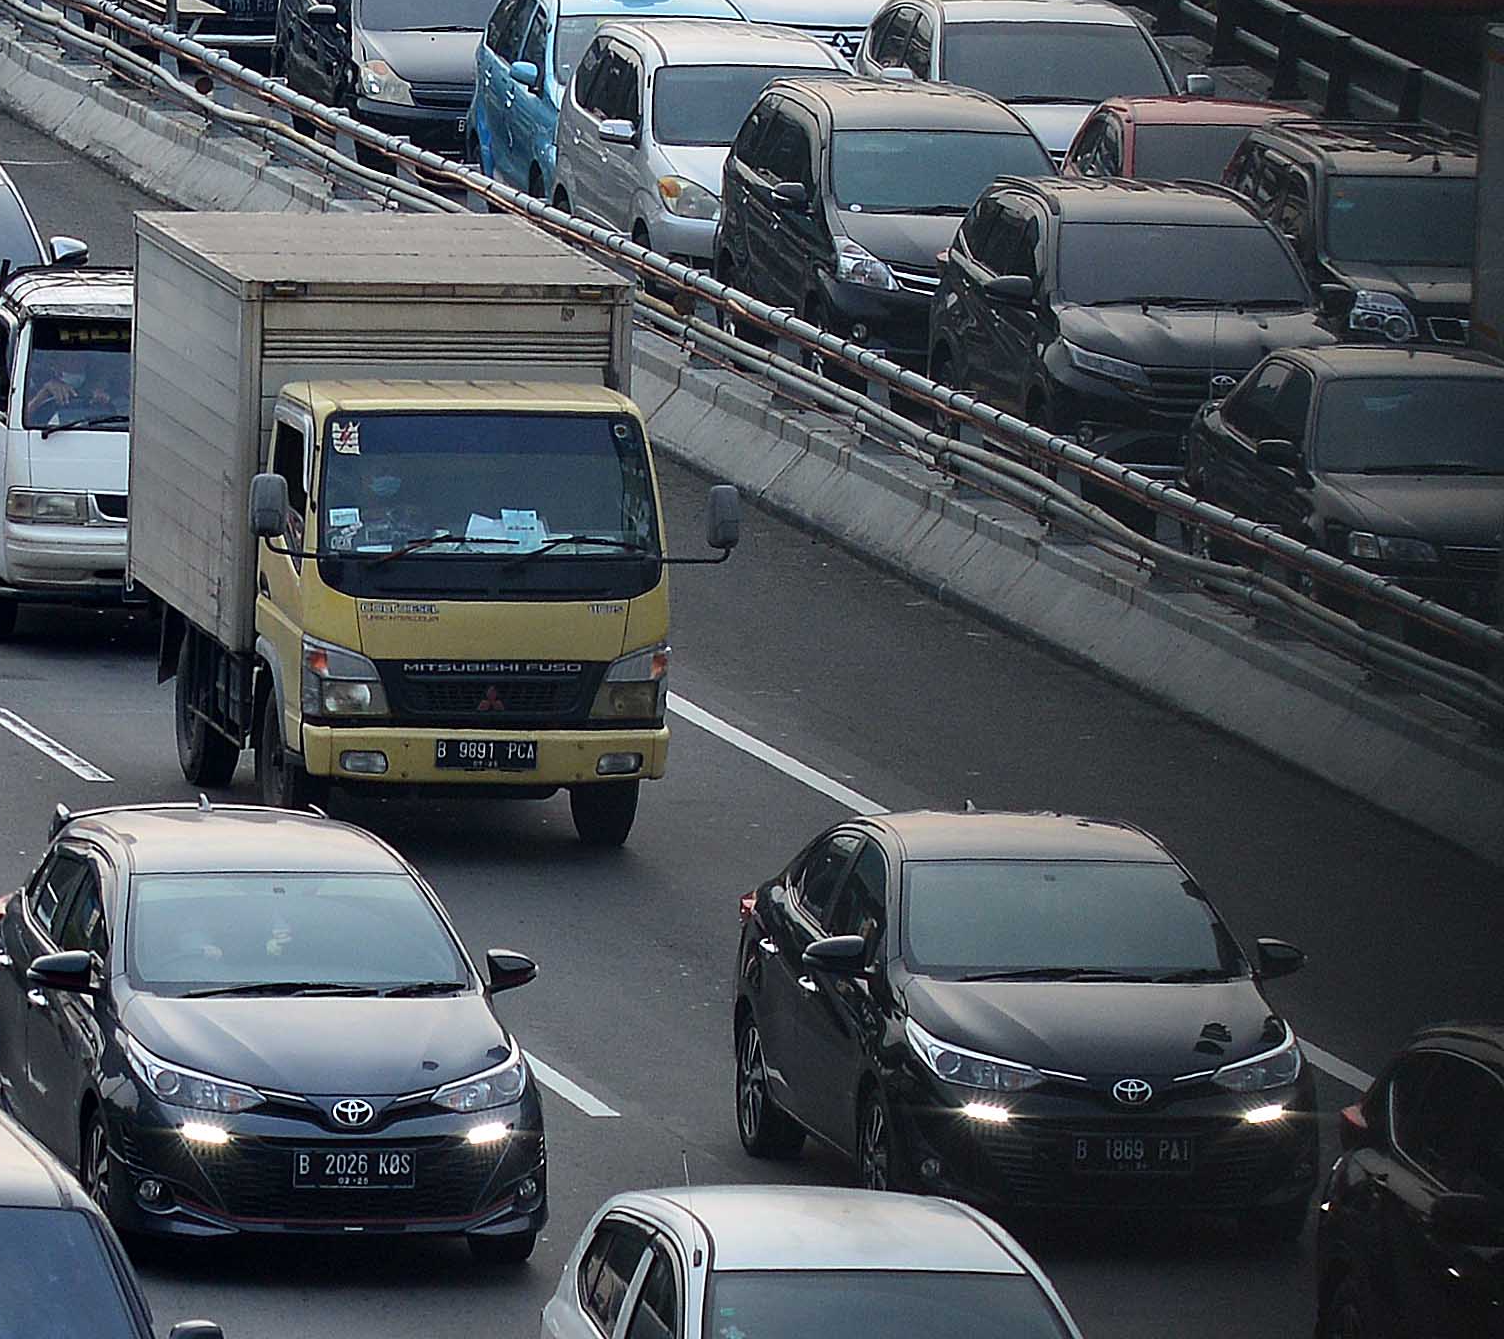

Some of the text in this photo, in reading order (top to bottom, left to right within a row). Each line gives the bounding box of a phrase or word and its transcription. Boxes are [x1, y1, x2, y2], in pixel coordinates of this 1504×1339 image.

[458, 119, 465, 132] B
[403, 662, 582, 673] MITSUBISHI FUSO
[437, 742, 534, 760] B 9891 PCA
[1076, 1138, 1088, 1160] B
[1105, 1138, 1145, 1161] 1869
[298, 1154, 309, 1174] B
[325, 1154, 368, 1175] 2026
